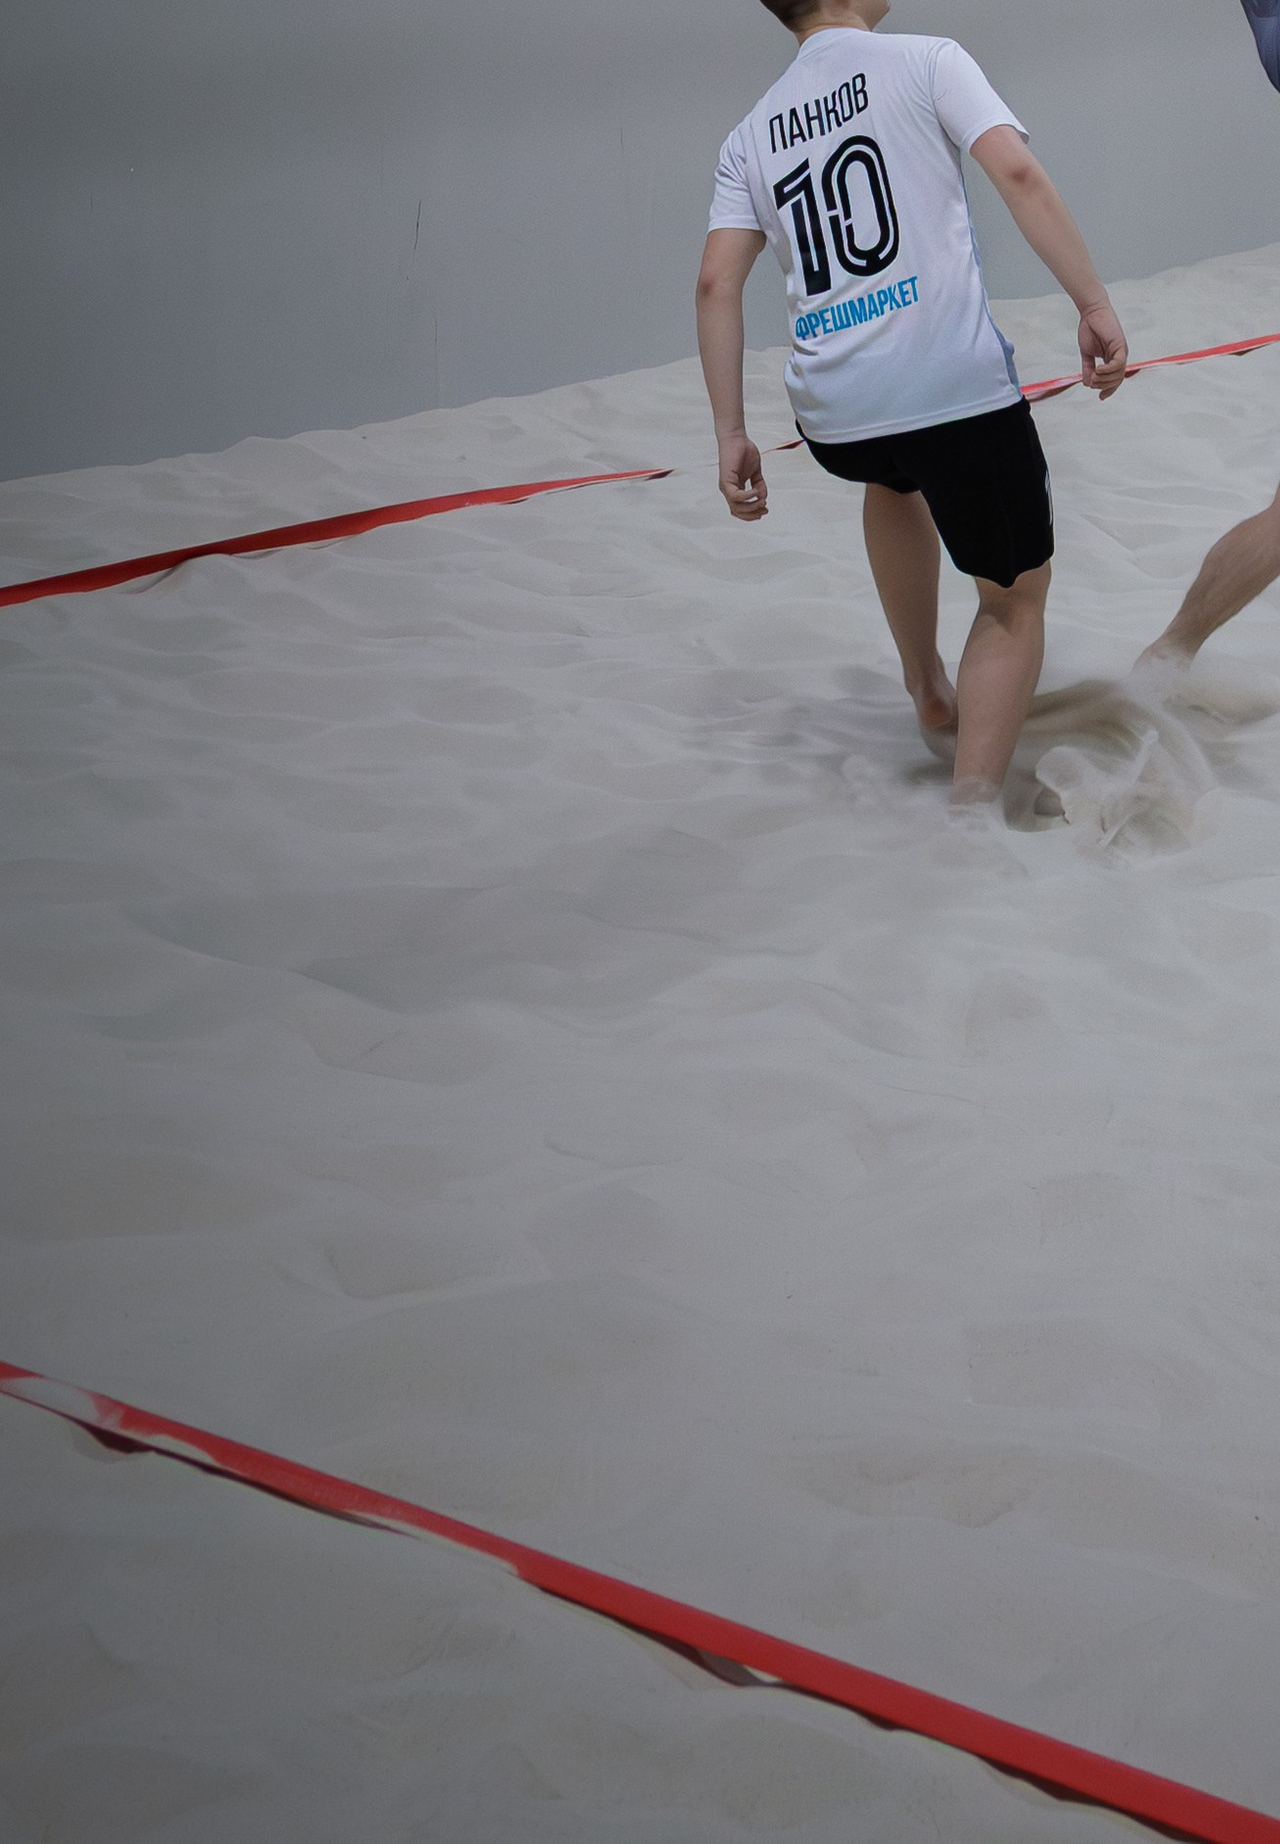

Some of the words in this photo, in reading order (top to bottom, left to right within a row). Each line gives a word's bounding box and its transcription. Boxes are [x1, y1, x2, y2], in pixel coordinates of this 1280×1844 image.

[769, 72, 869, 154] ПАНКОВ
[773, 135, 900, 297] 10
[795, 275, 919, 341] ФРЕШМАРКЕТ
